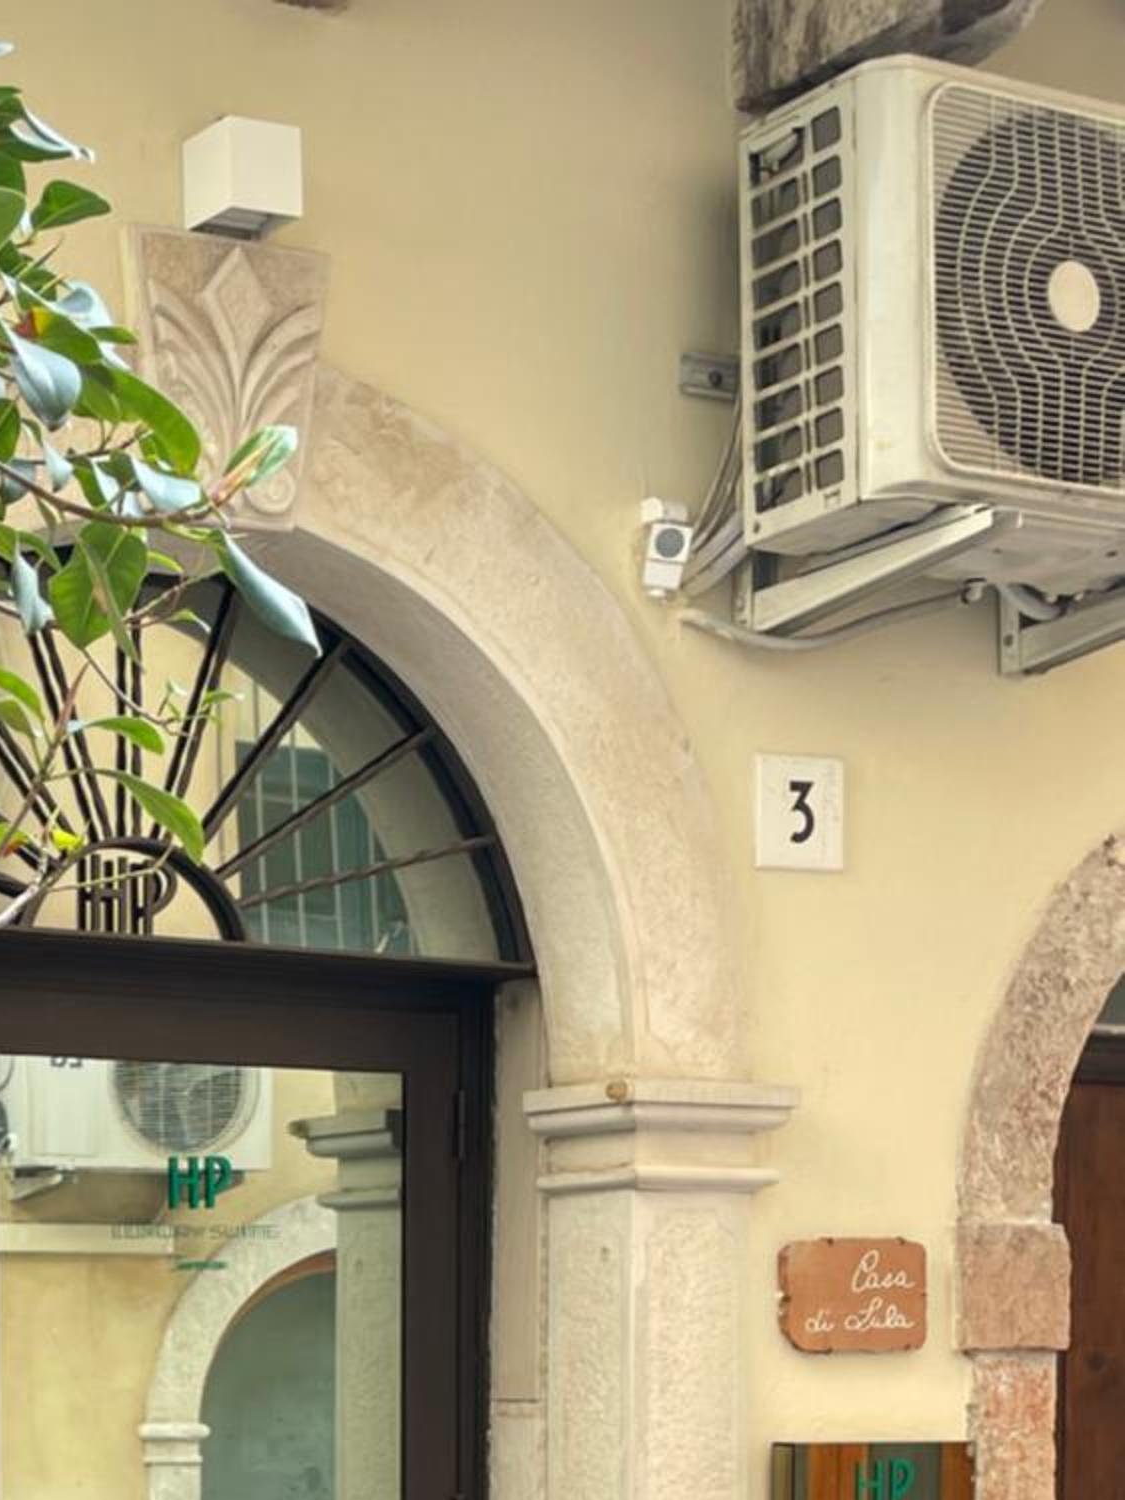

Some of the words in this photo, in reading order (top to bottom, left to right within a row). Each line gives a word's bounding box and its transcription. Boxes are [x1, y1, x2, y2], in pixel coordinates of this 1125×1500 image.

[788, 780, 815, 844] 3
[81, 854, 177, 938] HP
[167, 1155, 232, 1209] HP
[851, 1249, 916, 1292] Casa
[804, 1308, 835, 1333] di
